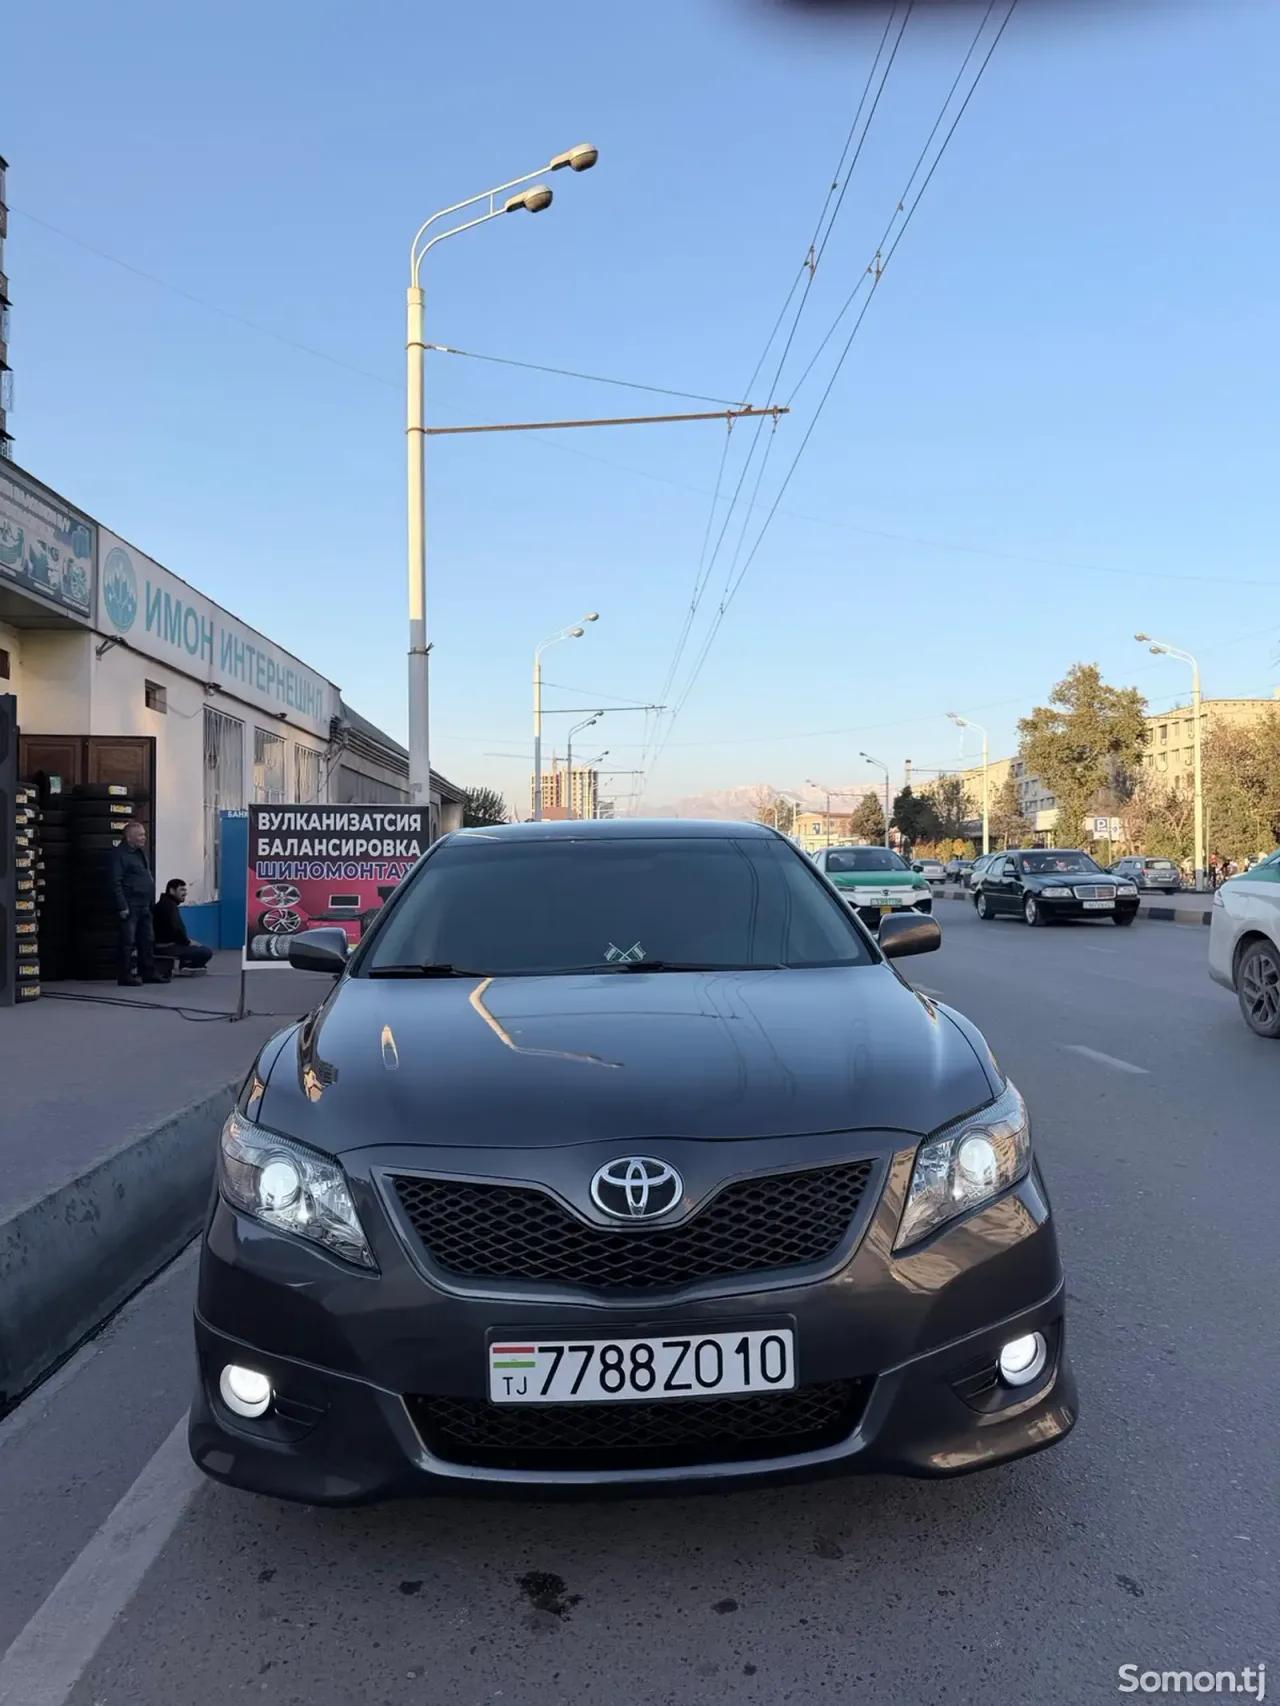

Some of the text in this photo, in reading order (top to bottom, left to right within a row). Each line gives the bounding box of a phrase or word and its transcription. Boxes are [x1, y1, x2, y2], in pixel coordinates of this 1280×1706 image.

[145, 580, 214, 665] ИМОН
[258, 812, 421, 832] ВУЛКАНИЗАТСИЯ
[257, 838, 421, 857] БАЛАНСИРОВКА
[502, 1376, 528, 1396] TJ
